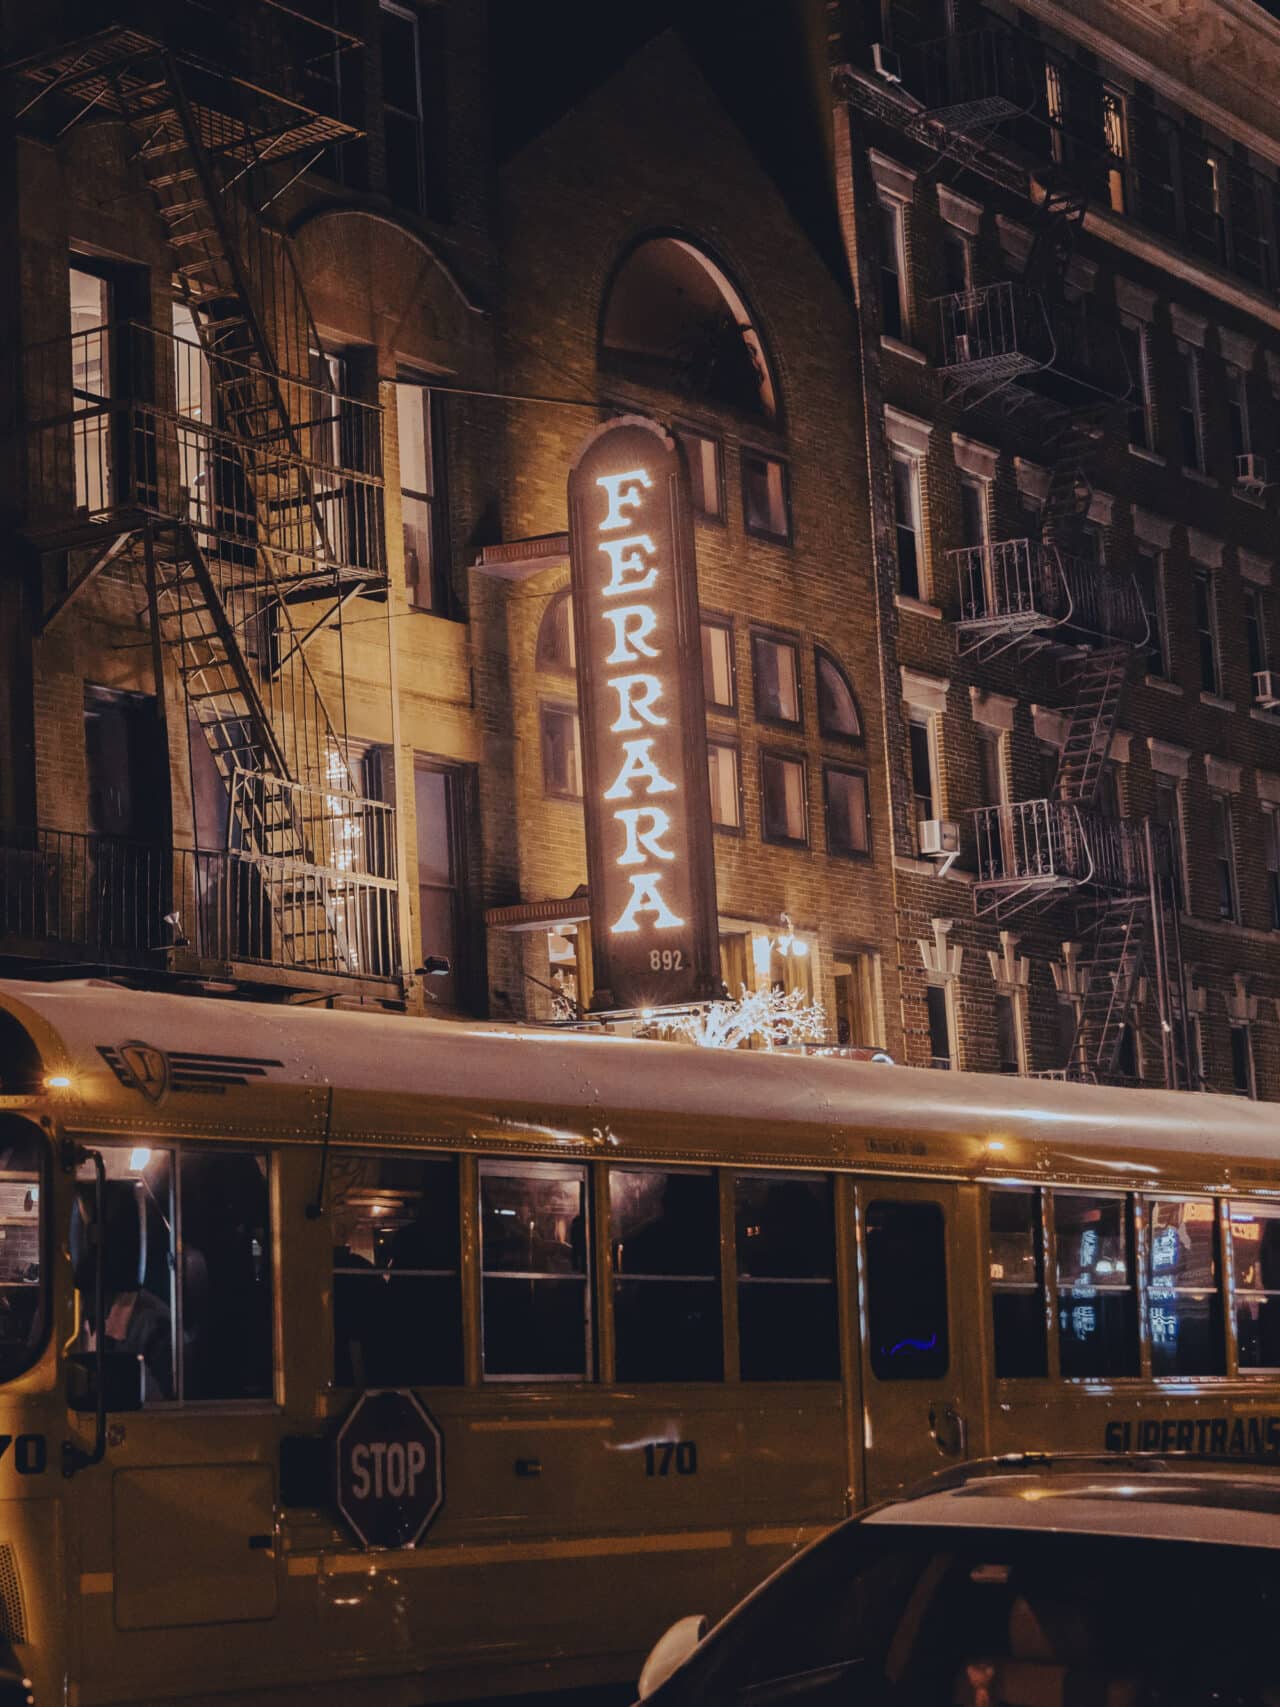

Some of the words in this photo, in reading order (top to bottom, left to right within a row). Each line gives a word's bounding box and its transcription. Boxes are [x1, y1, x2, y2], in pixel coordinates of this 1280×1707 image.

[596, 469, 685, 934] FERRARA
[650, 949, 683, 971] 892
[351, 1440, 427, 1500] STOP
[644, 1440, 697, 1476] 170
